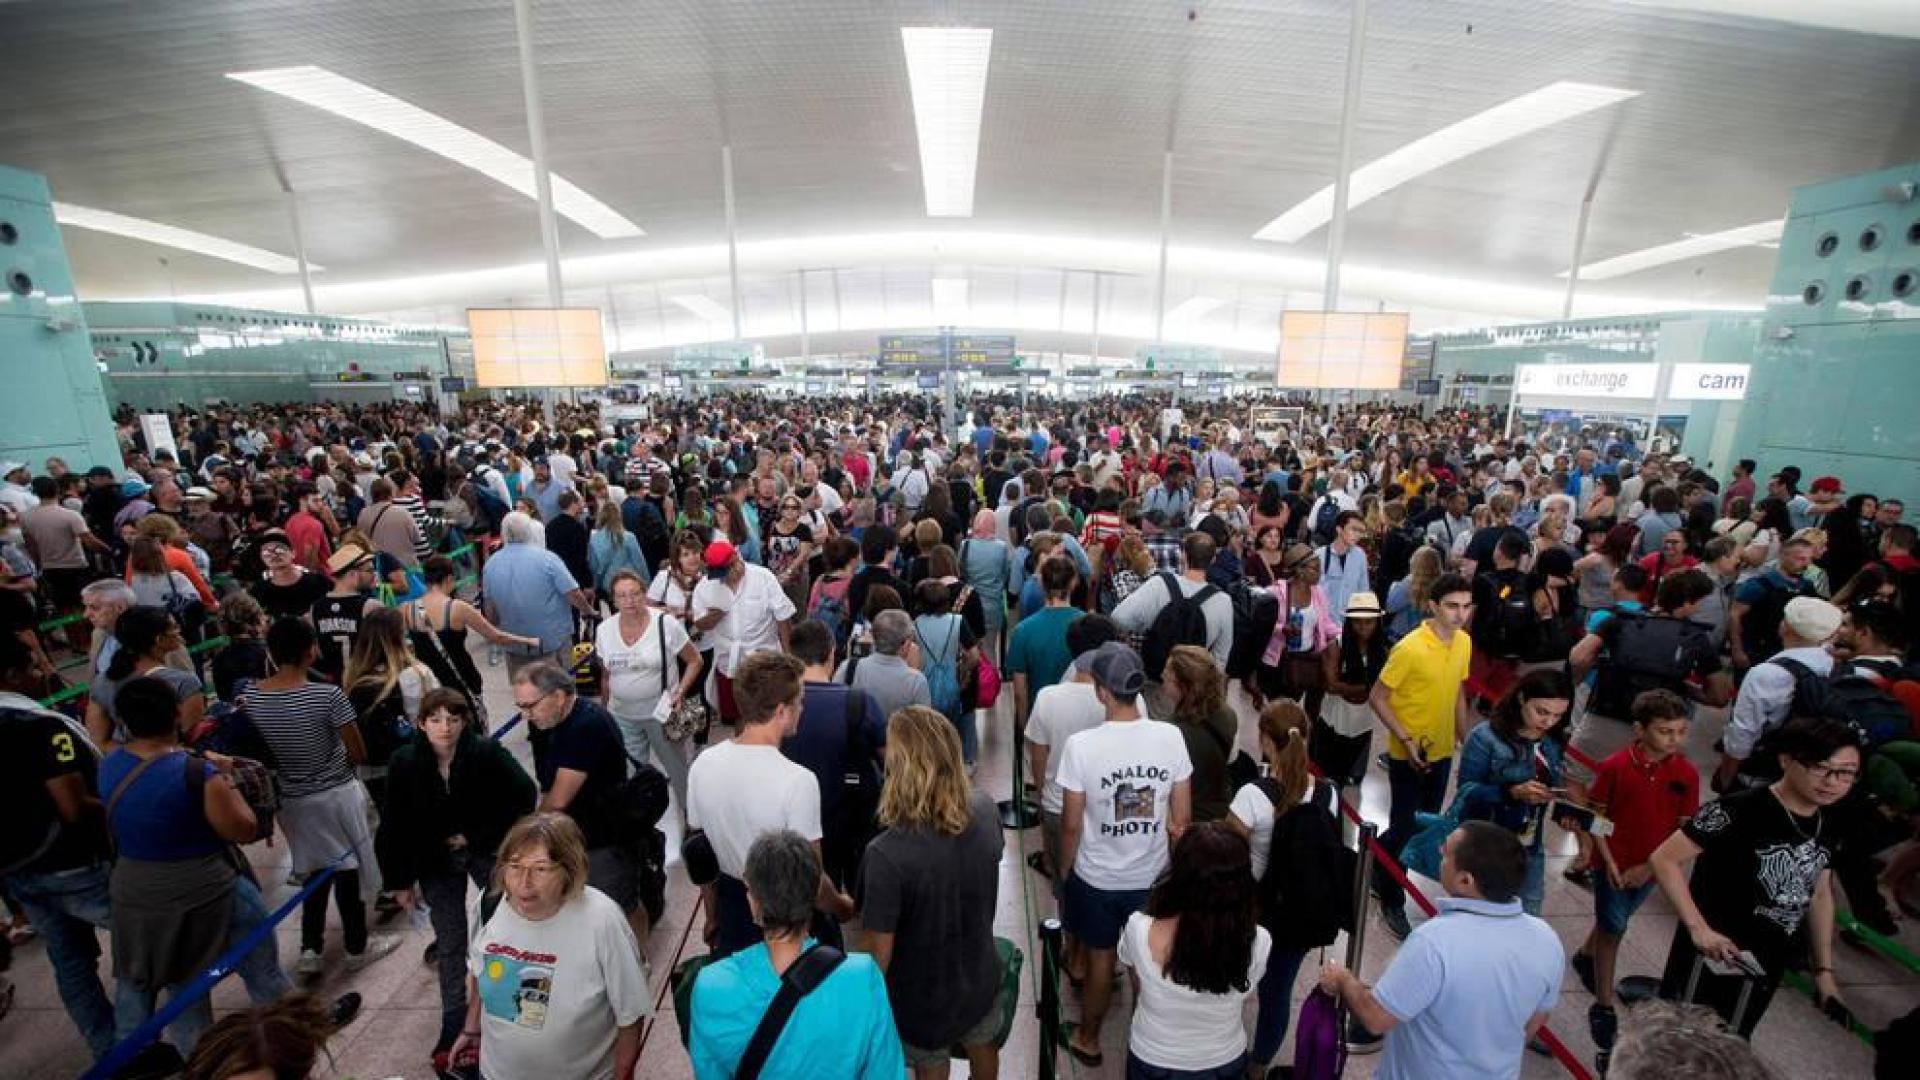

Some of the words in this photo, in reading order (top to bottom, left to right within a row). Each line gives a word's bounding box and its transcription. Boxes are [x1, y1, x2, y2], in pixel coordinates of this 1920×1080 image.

[1698, 373, 1745, 389] cam
[52, 733, 74, 762] 3
[1101, 766, 1169, 789] ANALOG
